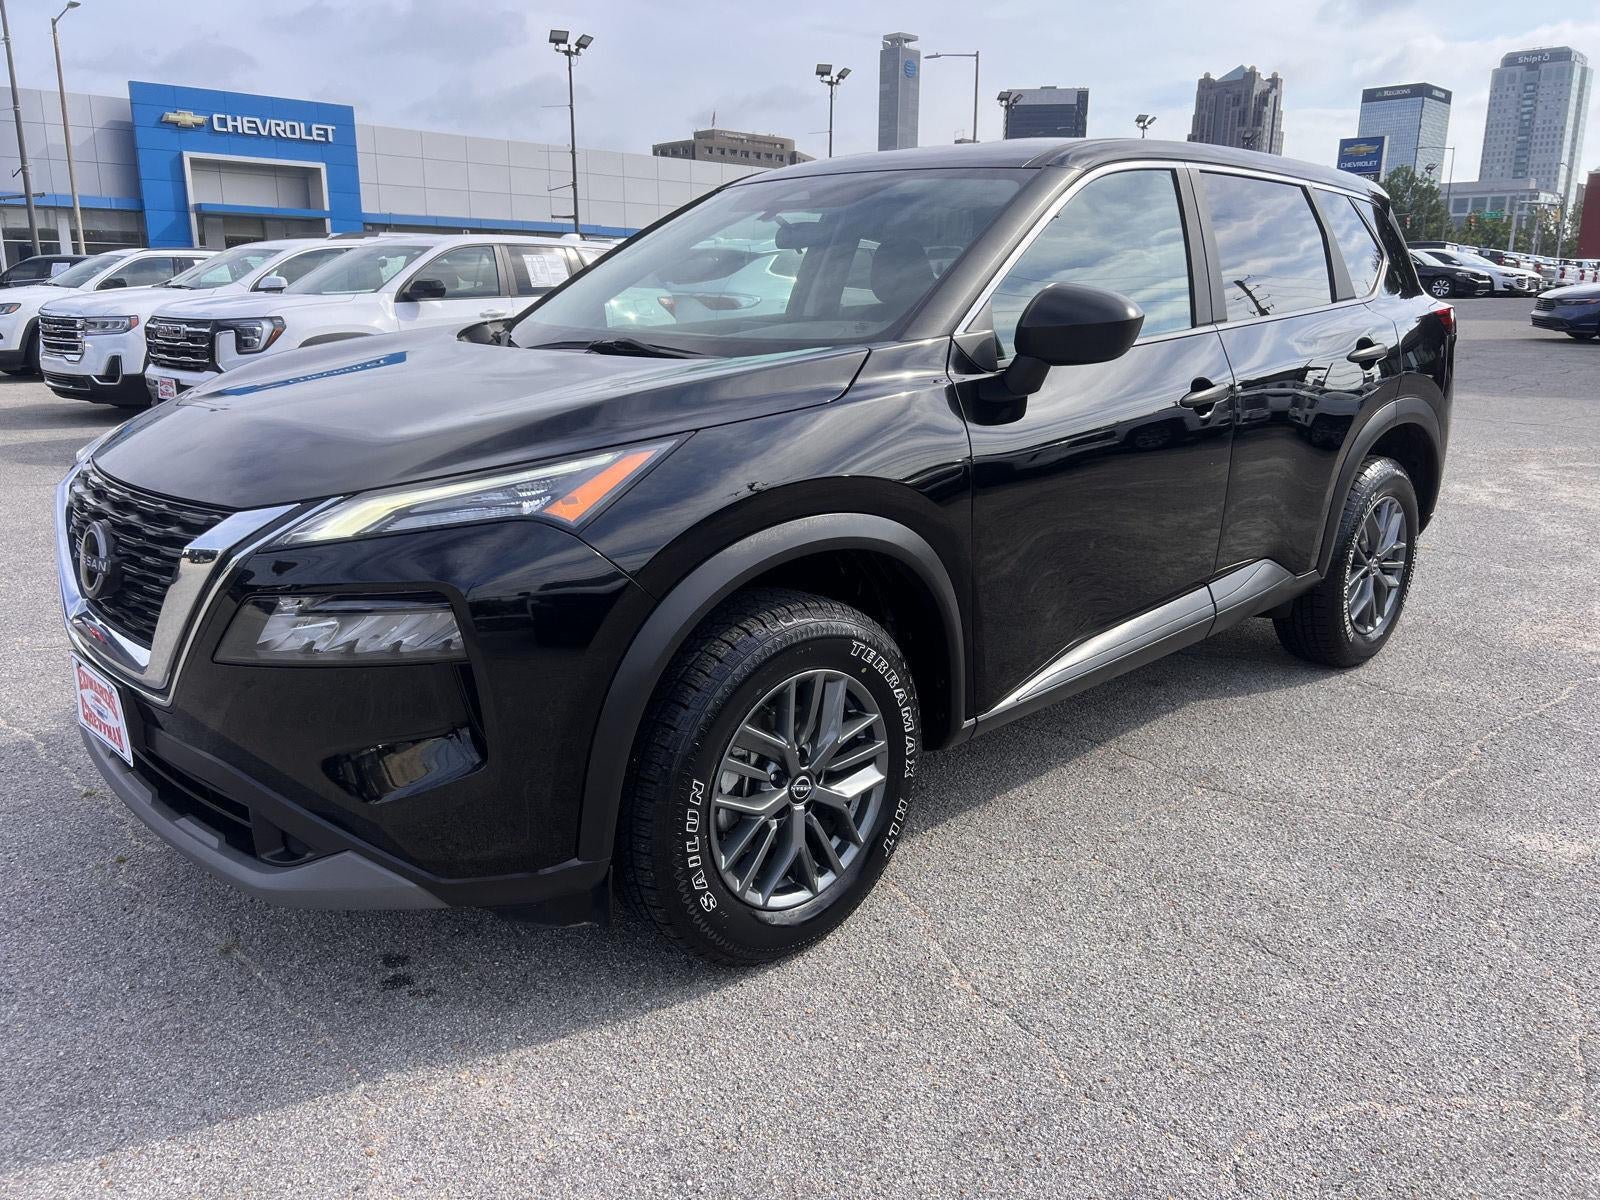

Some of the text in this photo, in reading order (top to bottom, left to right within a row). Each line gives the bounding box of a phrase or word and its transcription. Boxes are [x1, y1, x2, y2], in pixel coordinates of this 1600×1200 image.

[1518, 54, 1542, 64] Shipt
[212, 113, 336, 142] CHEVROLET
[1340, 160, 1377, 168] CHEVROLET
[850, 640, 915, 778] TERRAMAX
[686, 779, 717, 912] SAILUN
